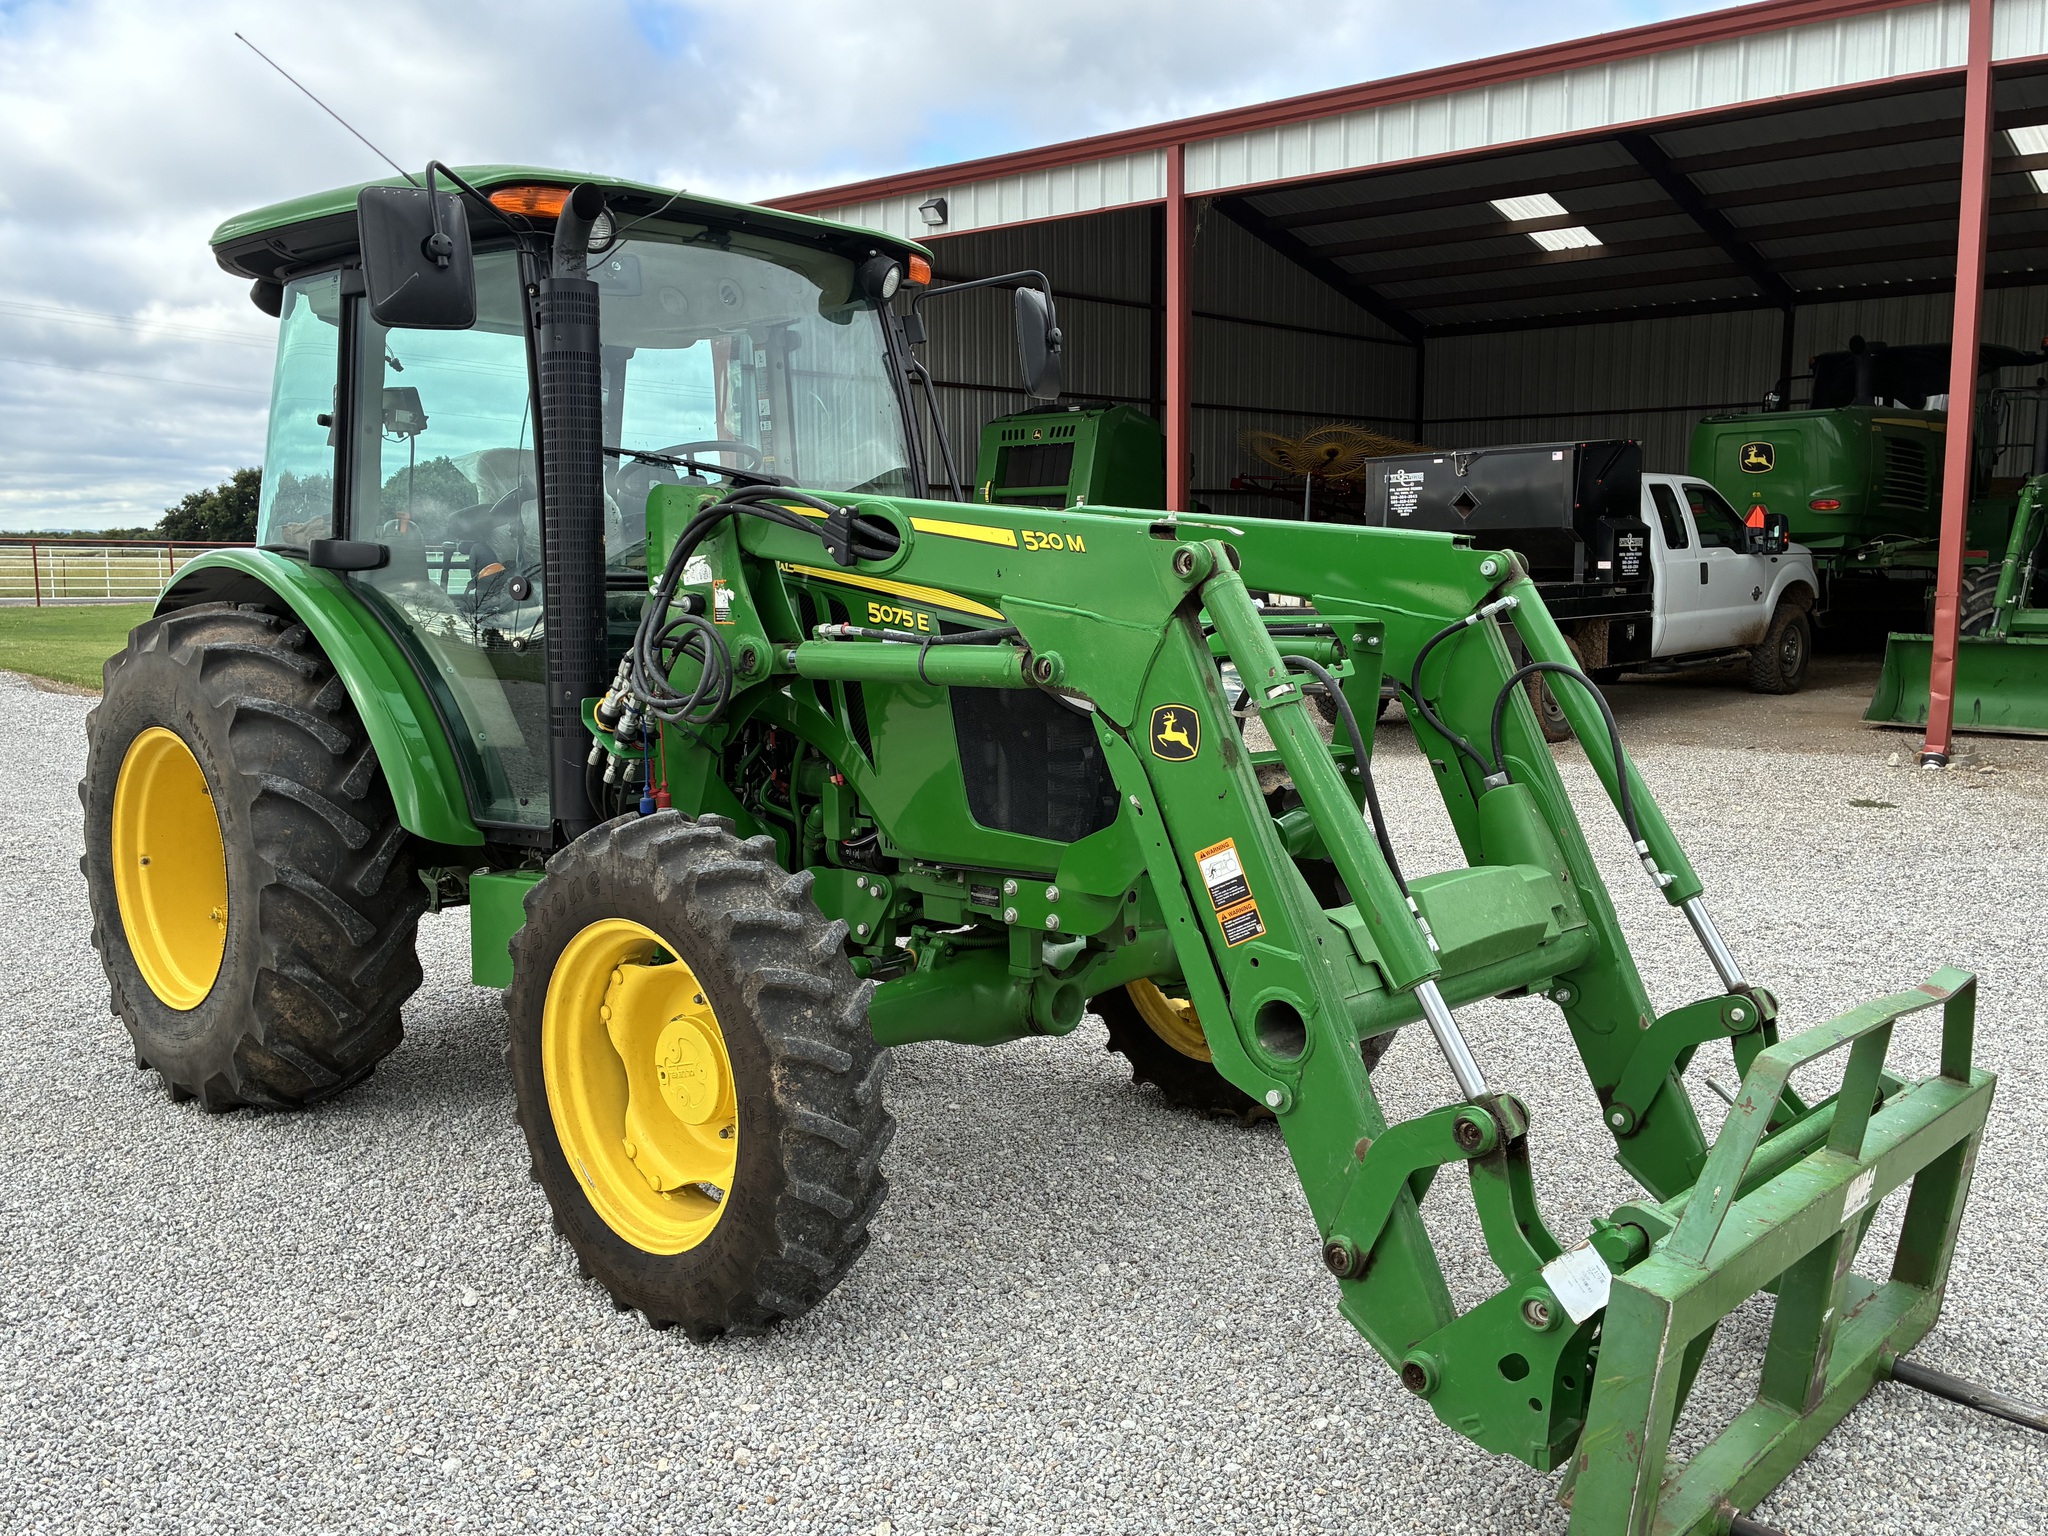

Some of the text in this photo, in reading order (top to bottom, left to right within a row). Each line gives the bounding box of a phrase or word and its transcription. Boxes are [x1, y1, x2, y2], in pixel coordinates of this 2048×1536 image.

[1020, 529, 1087, 553] 520 M
[867, 601, 930, 632] 5075 E
[1205, 842, 1230, 856] WARNING
[1227, 903, 1253, 917] WARNING
